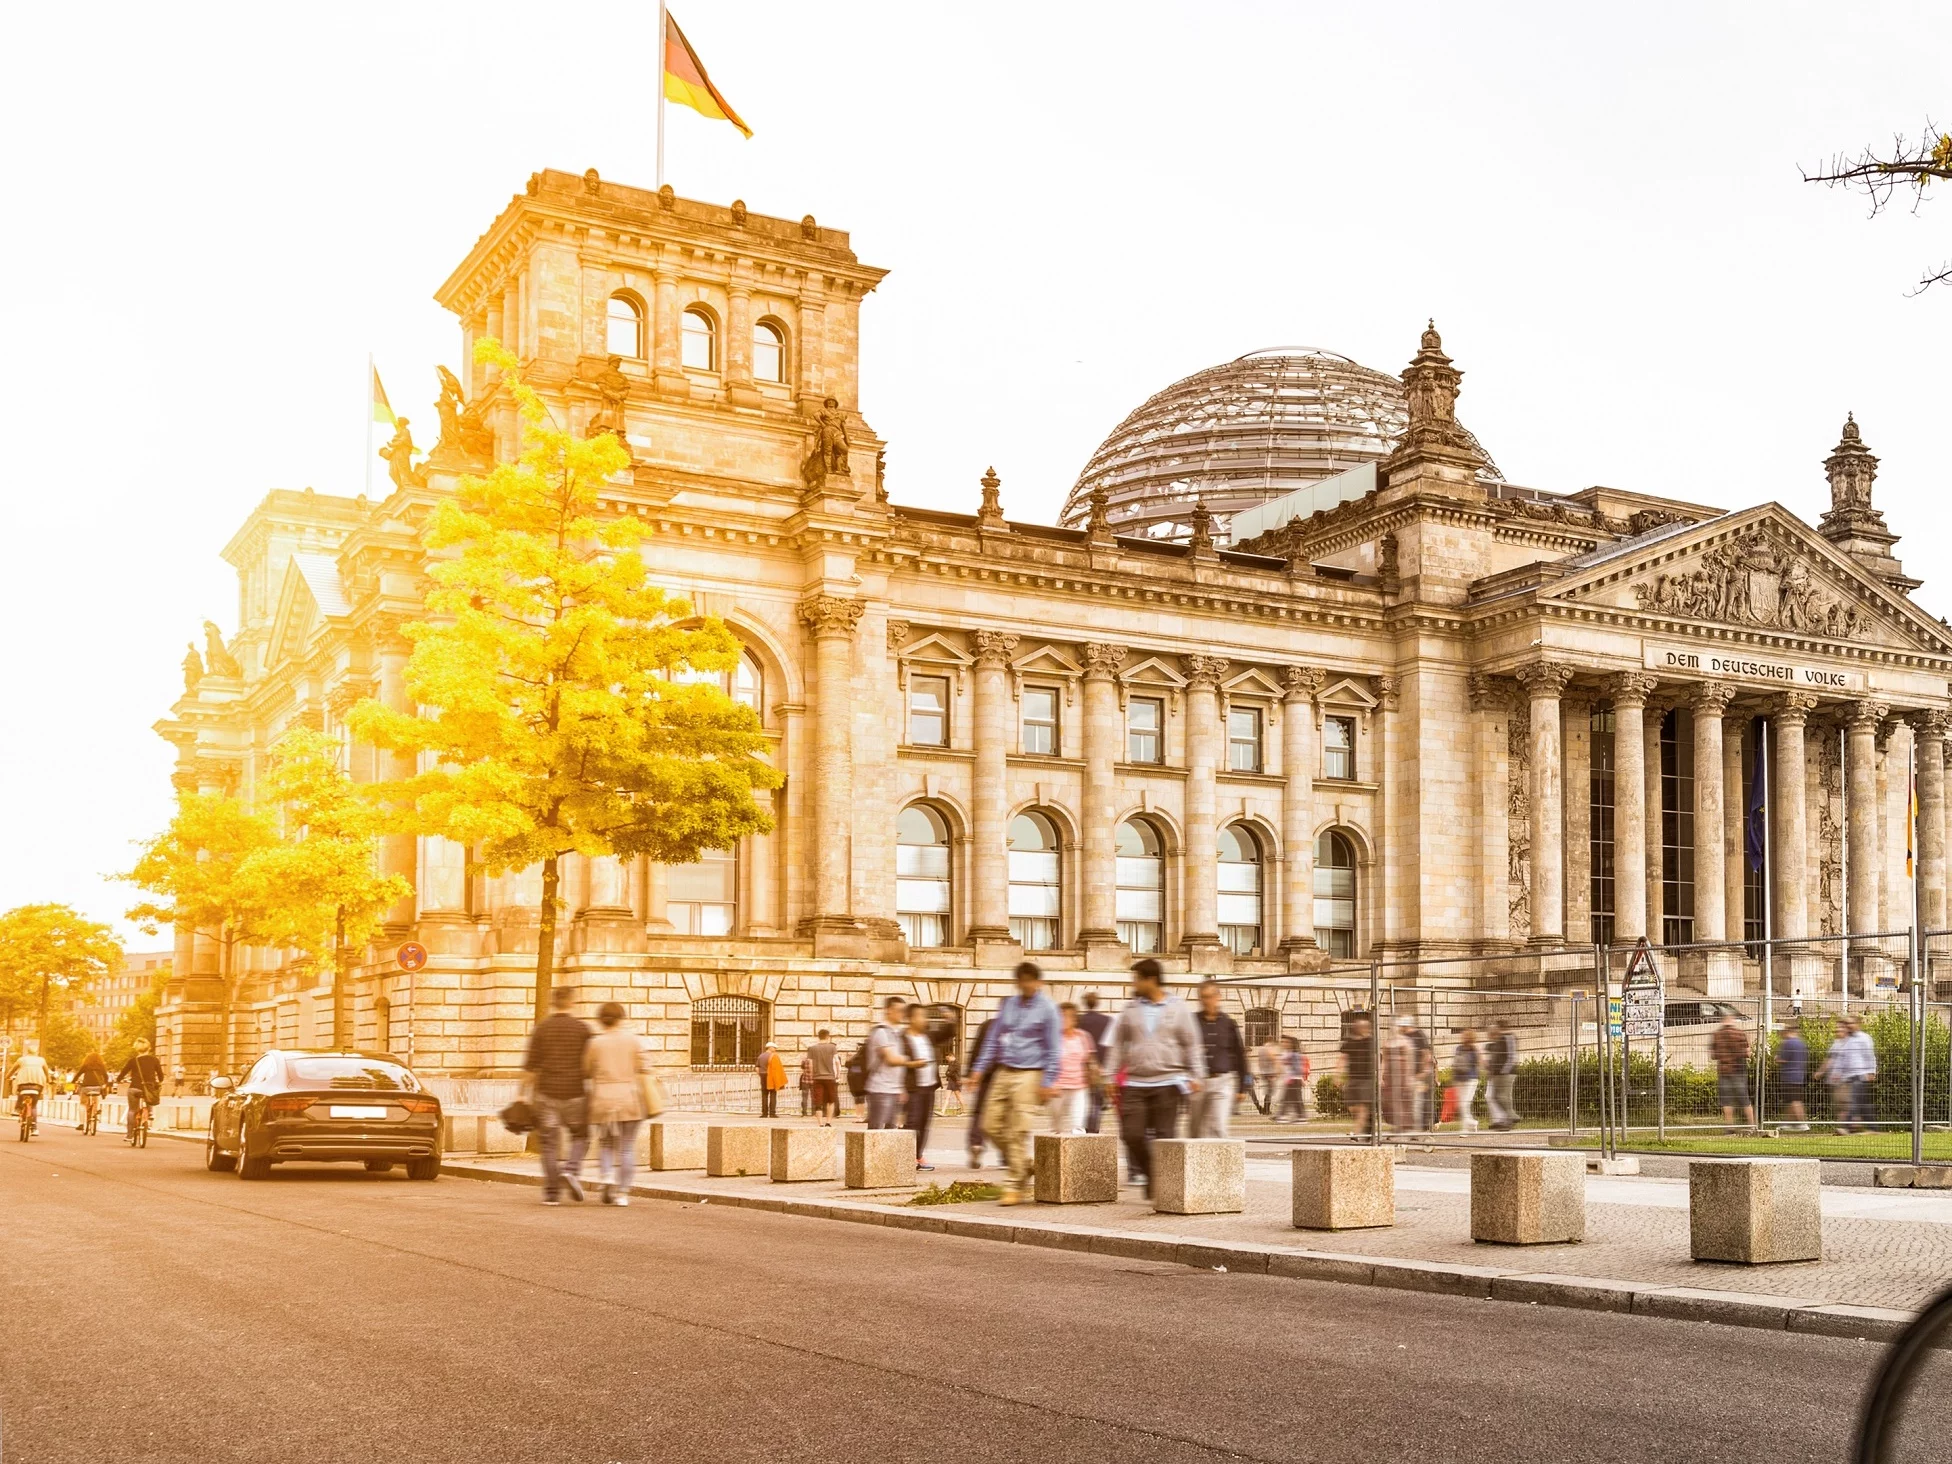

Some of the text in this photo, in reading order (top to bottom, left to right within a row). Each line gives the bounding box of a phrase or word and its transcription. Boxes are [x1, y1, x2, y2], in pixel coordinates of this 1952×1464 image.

[1666, 652, 1845, 687] DEM DEUTSCHEN VOLKE
